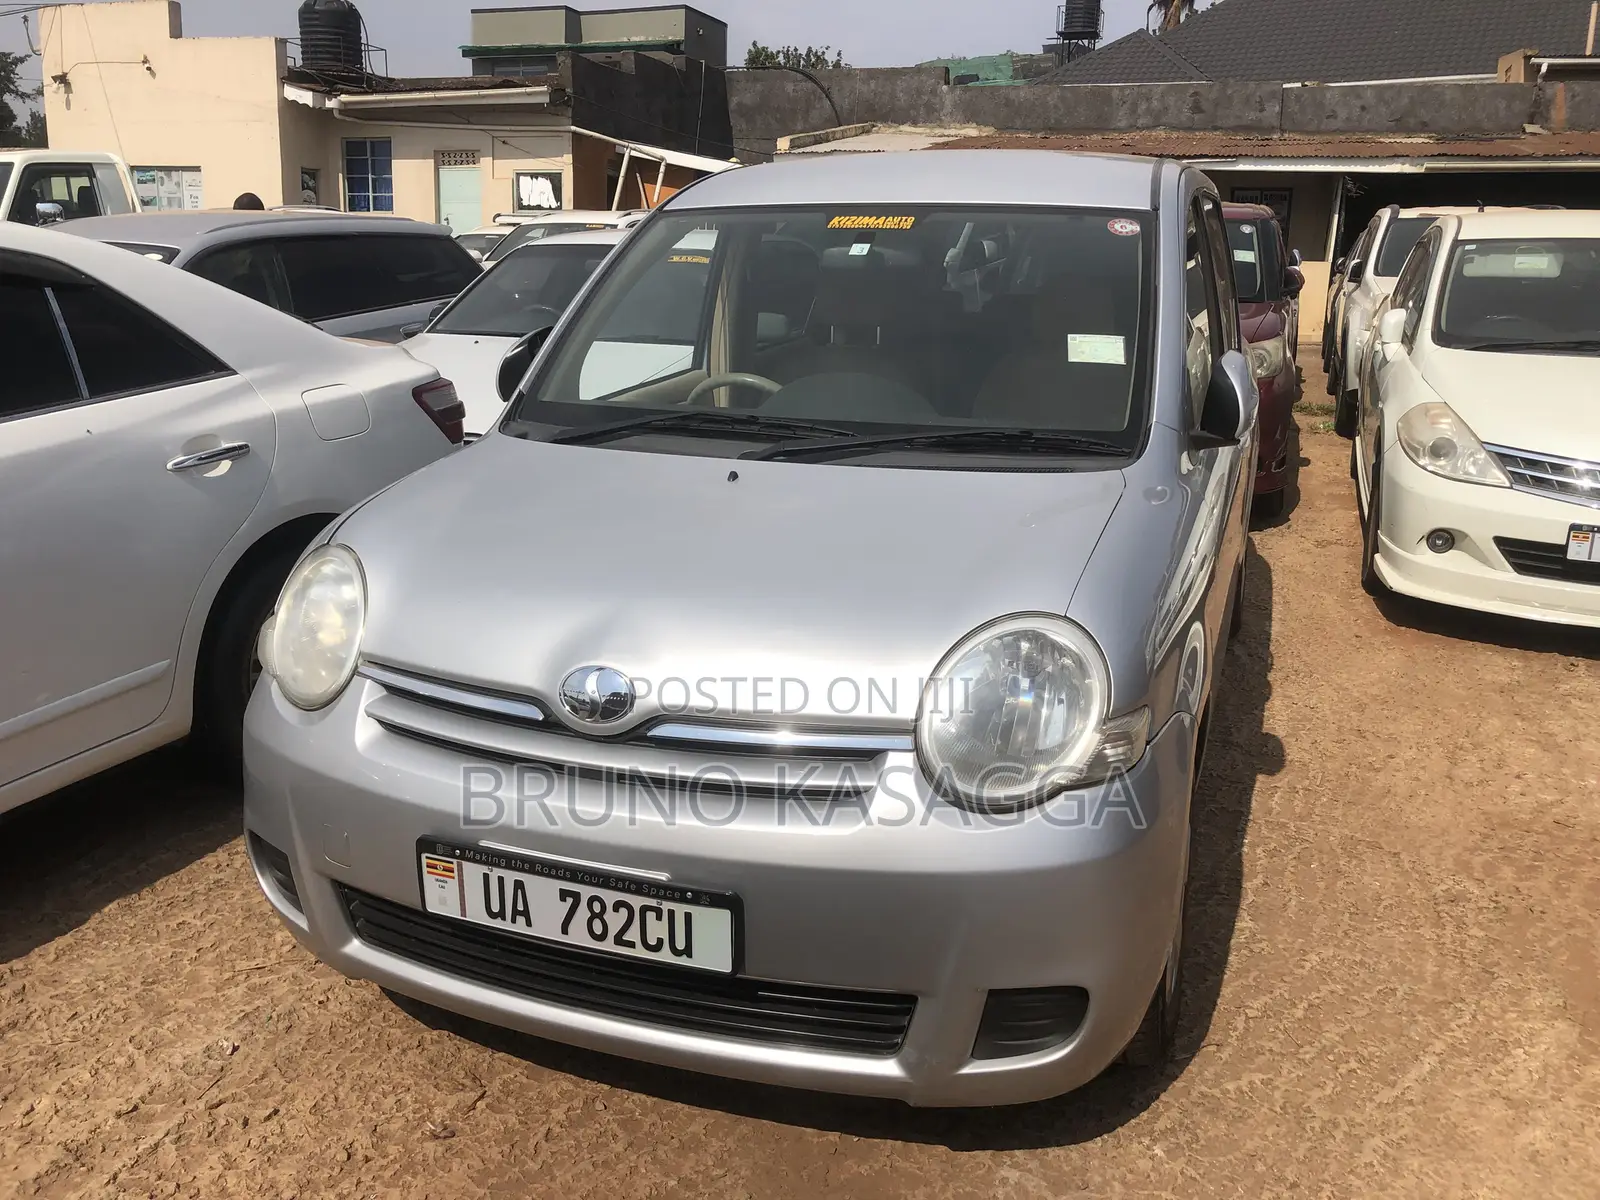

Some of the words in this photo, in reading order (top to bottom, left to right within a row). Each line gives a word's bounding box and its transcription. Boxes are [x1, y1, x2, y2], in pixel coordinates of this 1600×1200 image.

[829, 216, 886, 225] KIZIMA
[465, 850, 506, 867] Making
[511, 859, 530, 870] the
[535, 864, 571, 878] Roads
[577, 872, 604, 885] Your
[609, 878, 637, 891] Safe
[642, 884, 681, 899] Space
[482, 872, 533, 928] UA
[558, 887, 694, 959] 782CU
